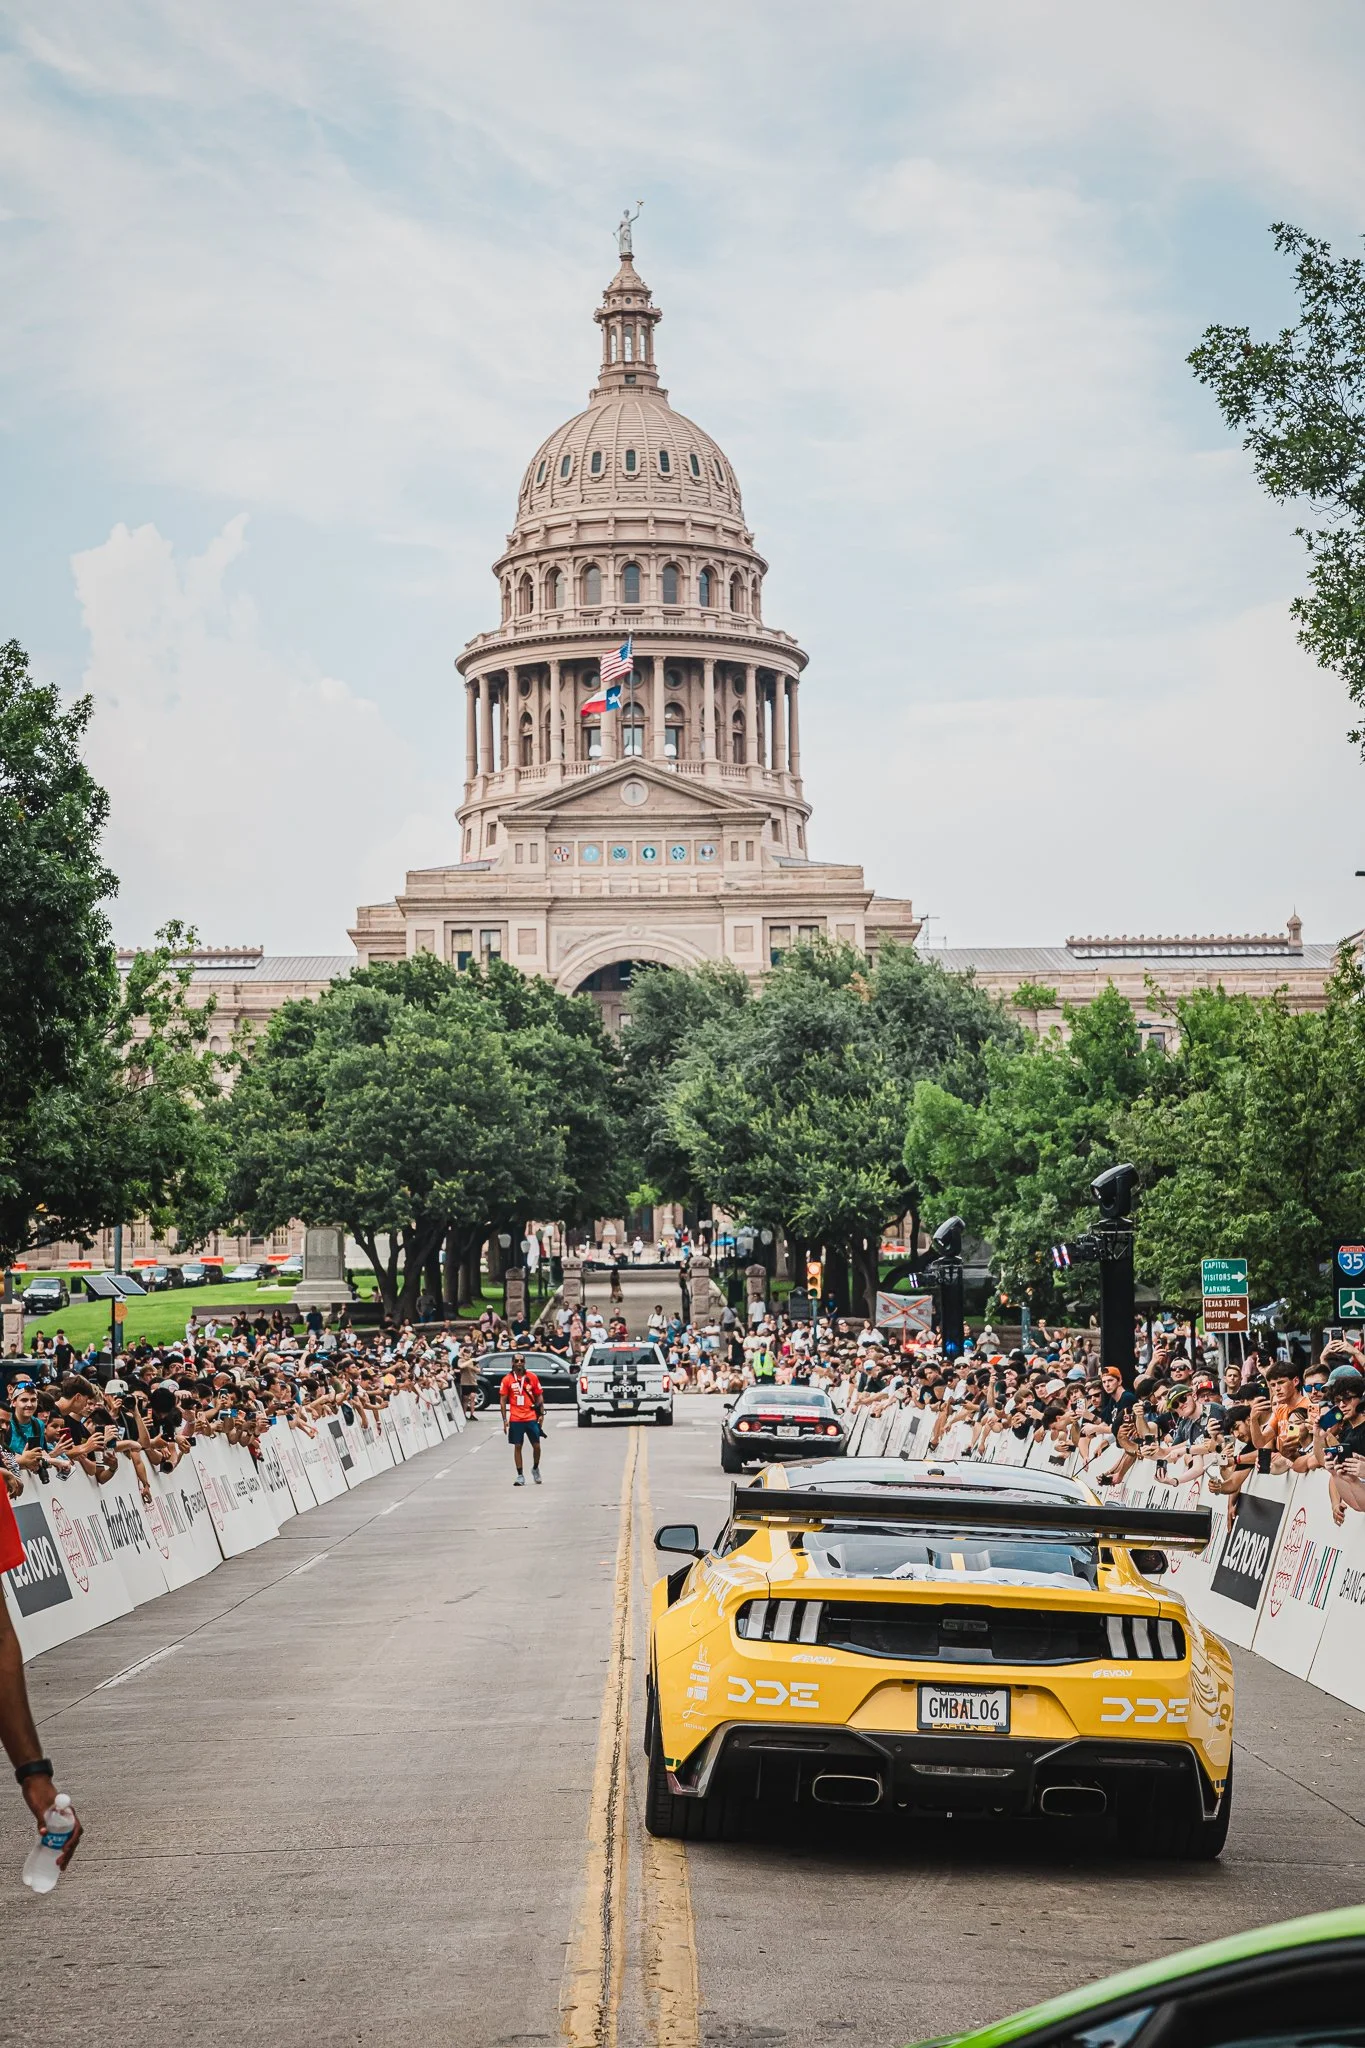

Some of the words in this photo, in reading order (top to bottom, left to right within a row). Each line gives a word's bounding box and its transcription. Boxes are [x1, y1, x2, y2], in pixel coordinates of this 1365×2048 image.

[1204, 1261, 1229, 1269] CAPITOL
[1343, 1253, 1363, 1270] 35
[1203, 1273, 1231, 1281] VISITORS
[1205, 1299, 1222, 1307] TEXAS
[1224, 1299, 1240, 1307] STATE
[607, 1384, 643, 1393] Lenovo
[101, 1496, 130, 1550] Hard
[118, 1493, 150, 1554] Rock
[1222, 1515, 1269, 1580] Lenovo
[1103, 1669, 1133, 1677] EVOLV
[929, 1697, 999, 1720] GMBAL06
[932, 1723, 995, 1732] CARTUNES
